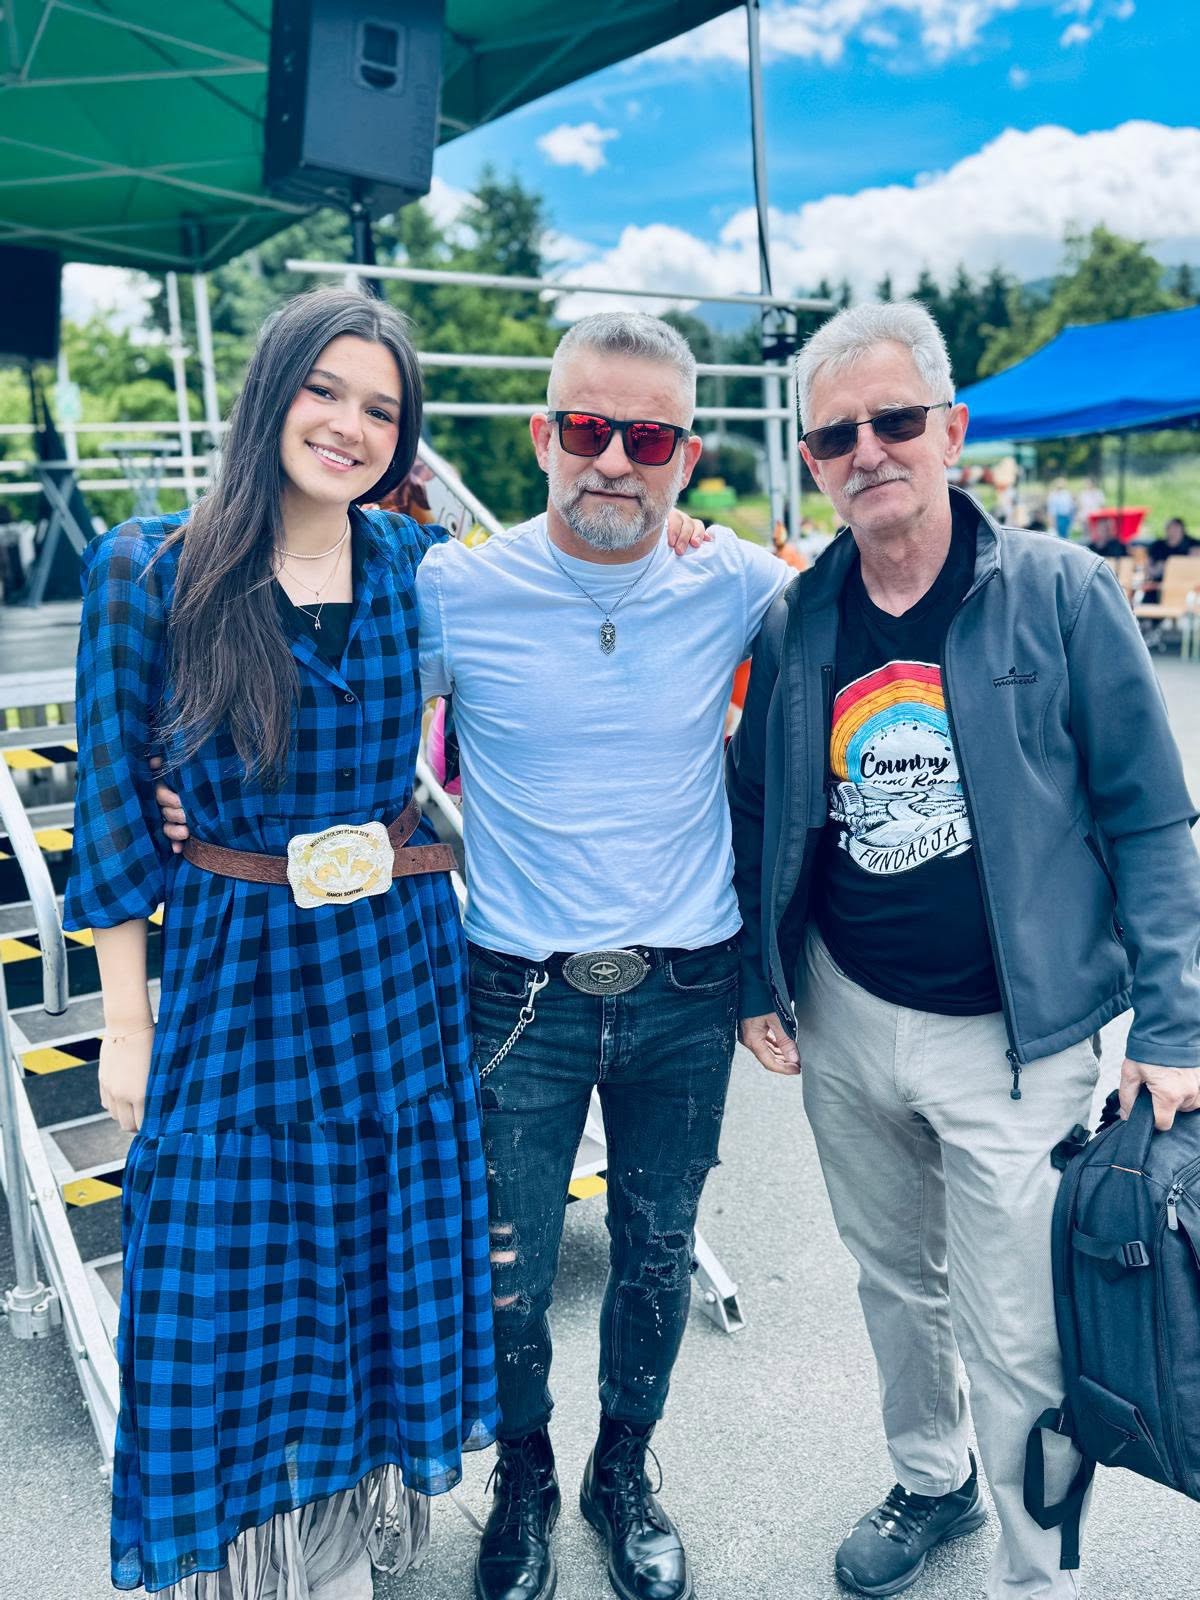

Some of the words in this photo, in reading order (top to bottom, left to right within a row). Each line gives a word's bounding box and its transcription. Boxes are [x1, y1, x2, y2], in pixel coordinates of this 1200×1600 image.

[860, 752, 950, 778] Country
[859, 822, 958, 871] FUNDACJA
[344, 887, 364, 897] SORTING
